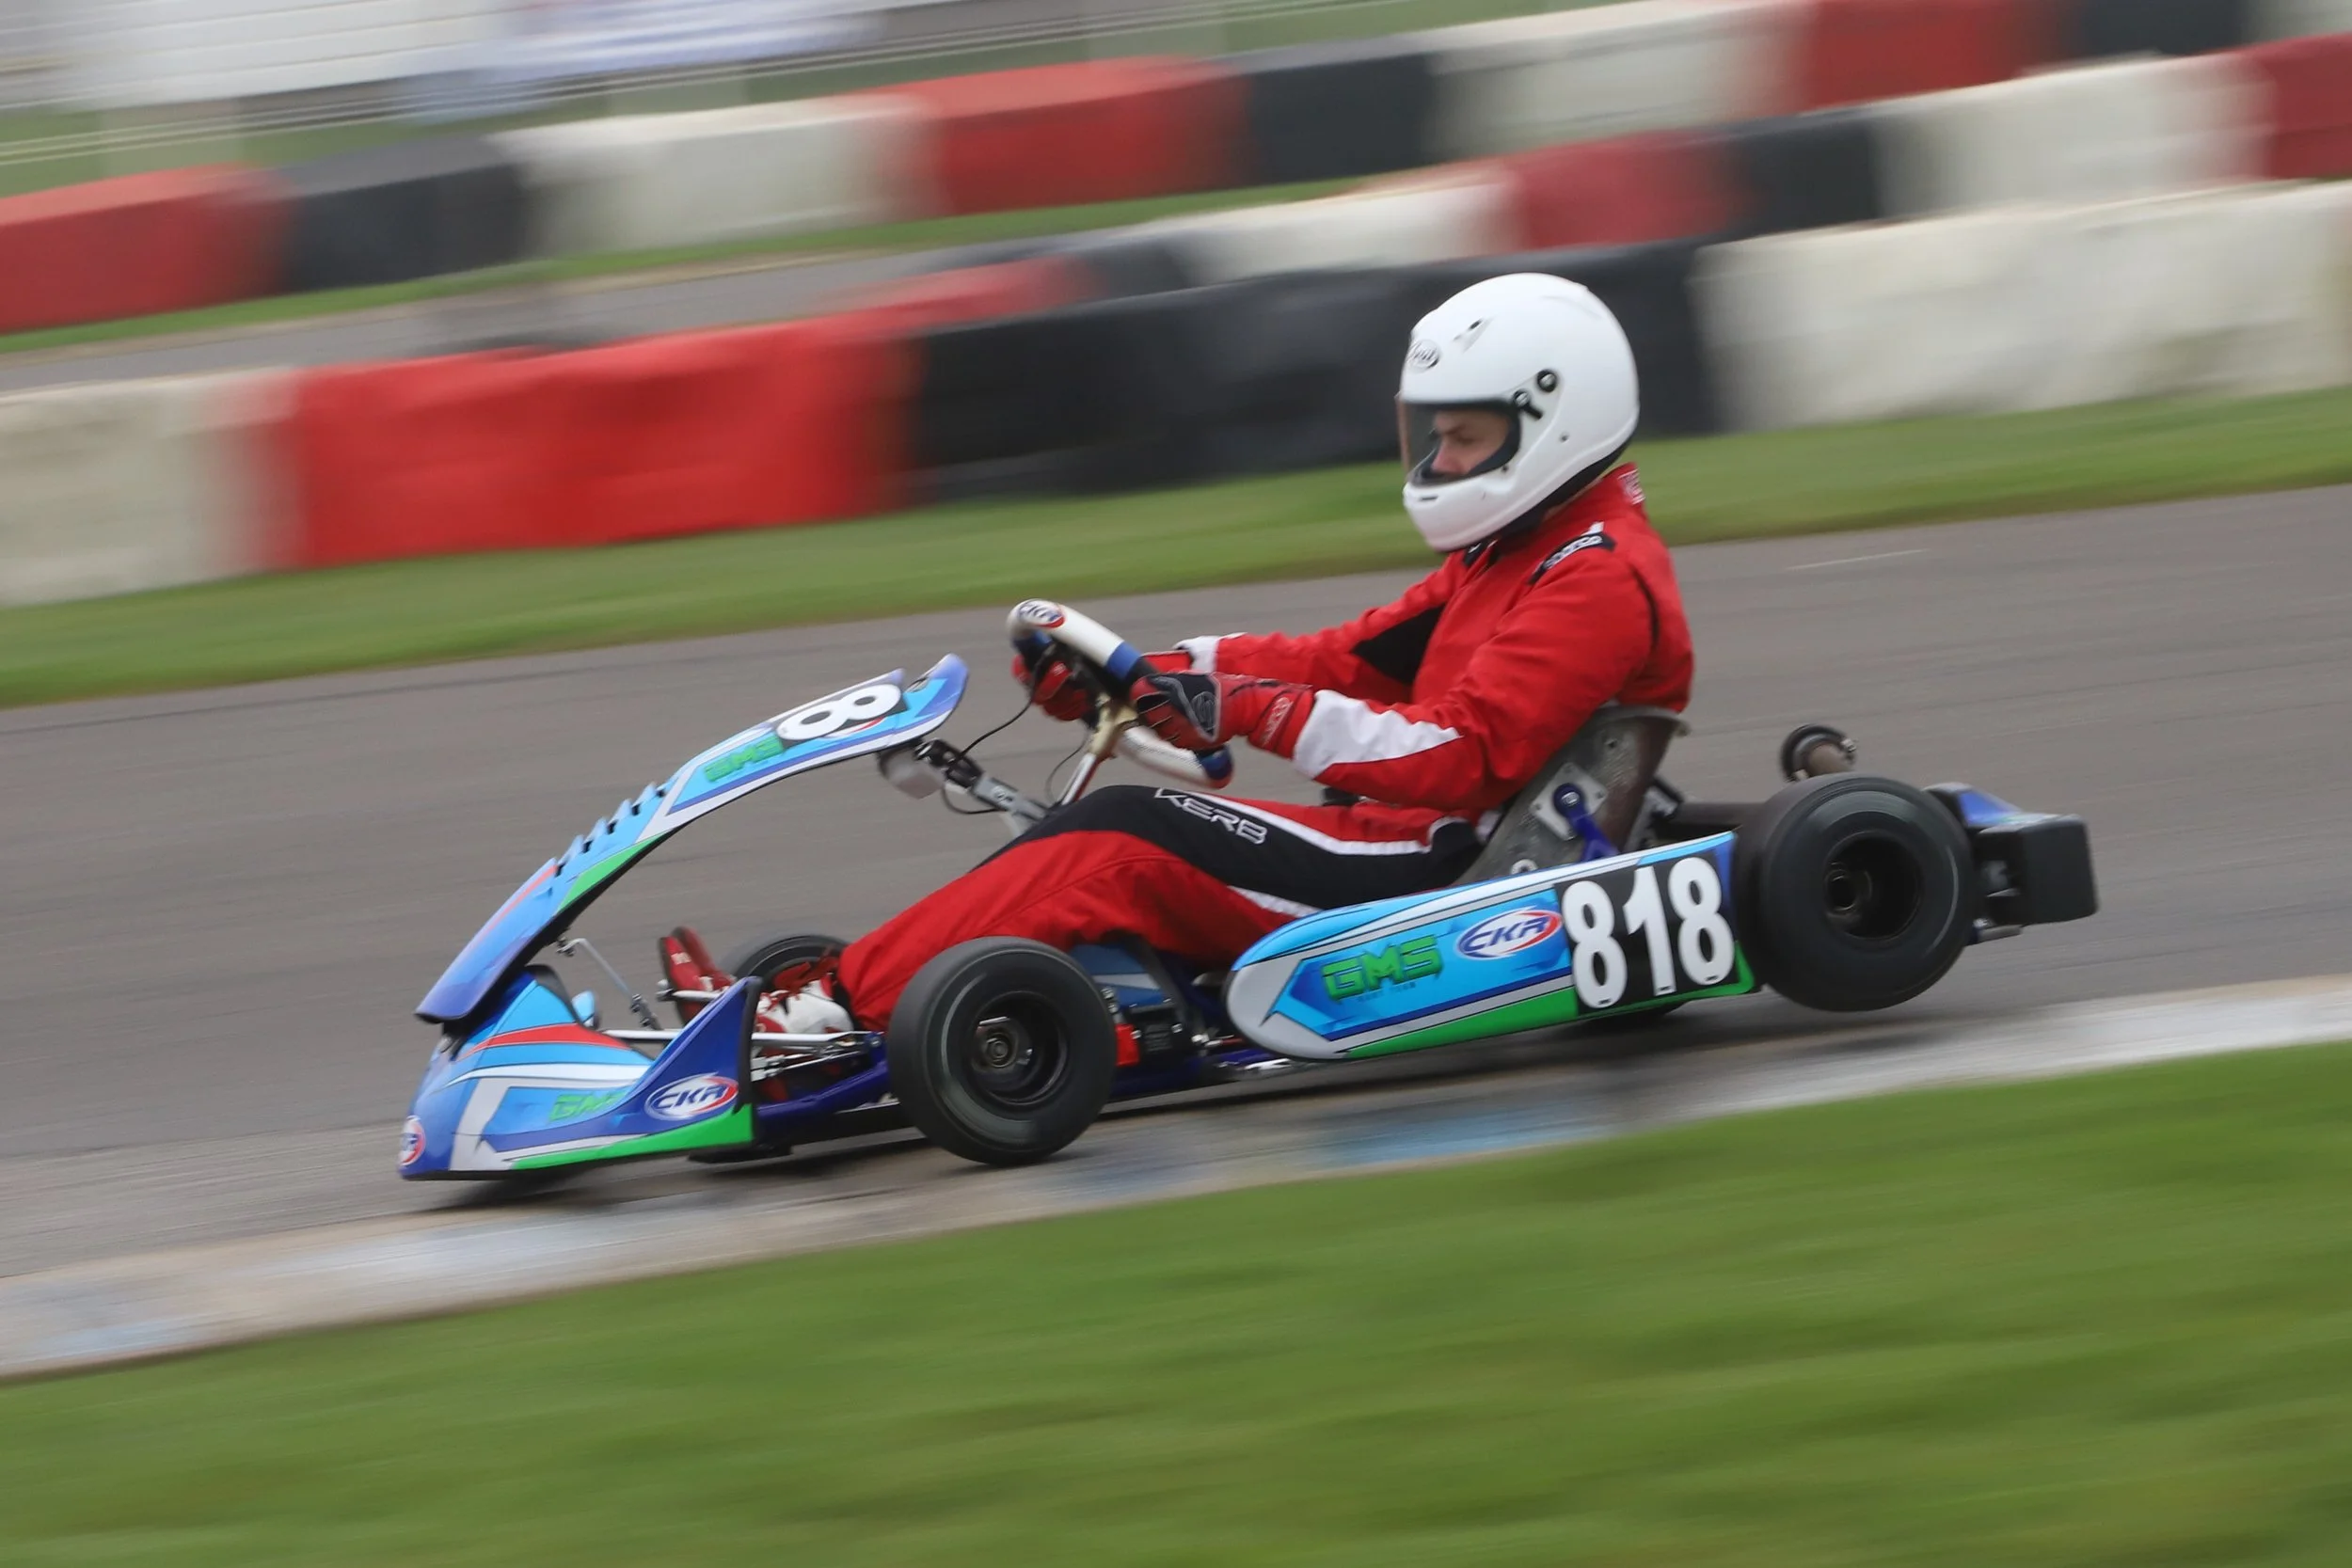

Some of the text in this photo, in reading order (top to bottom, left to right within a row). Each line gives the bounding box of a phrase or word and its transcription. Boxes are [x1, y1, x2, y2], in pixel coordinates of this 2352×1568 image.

[1153, 787, 1267, 845] KERB
[1463, 914, 1552, 953] CKR
[1562, 857, 1735, 1008] 818
[1322, 934, 1444, 1004] GMS
[650, 1083, 730, 1110] CKR
